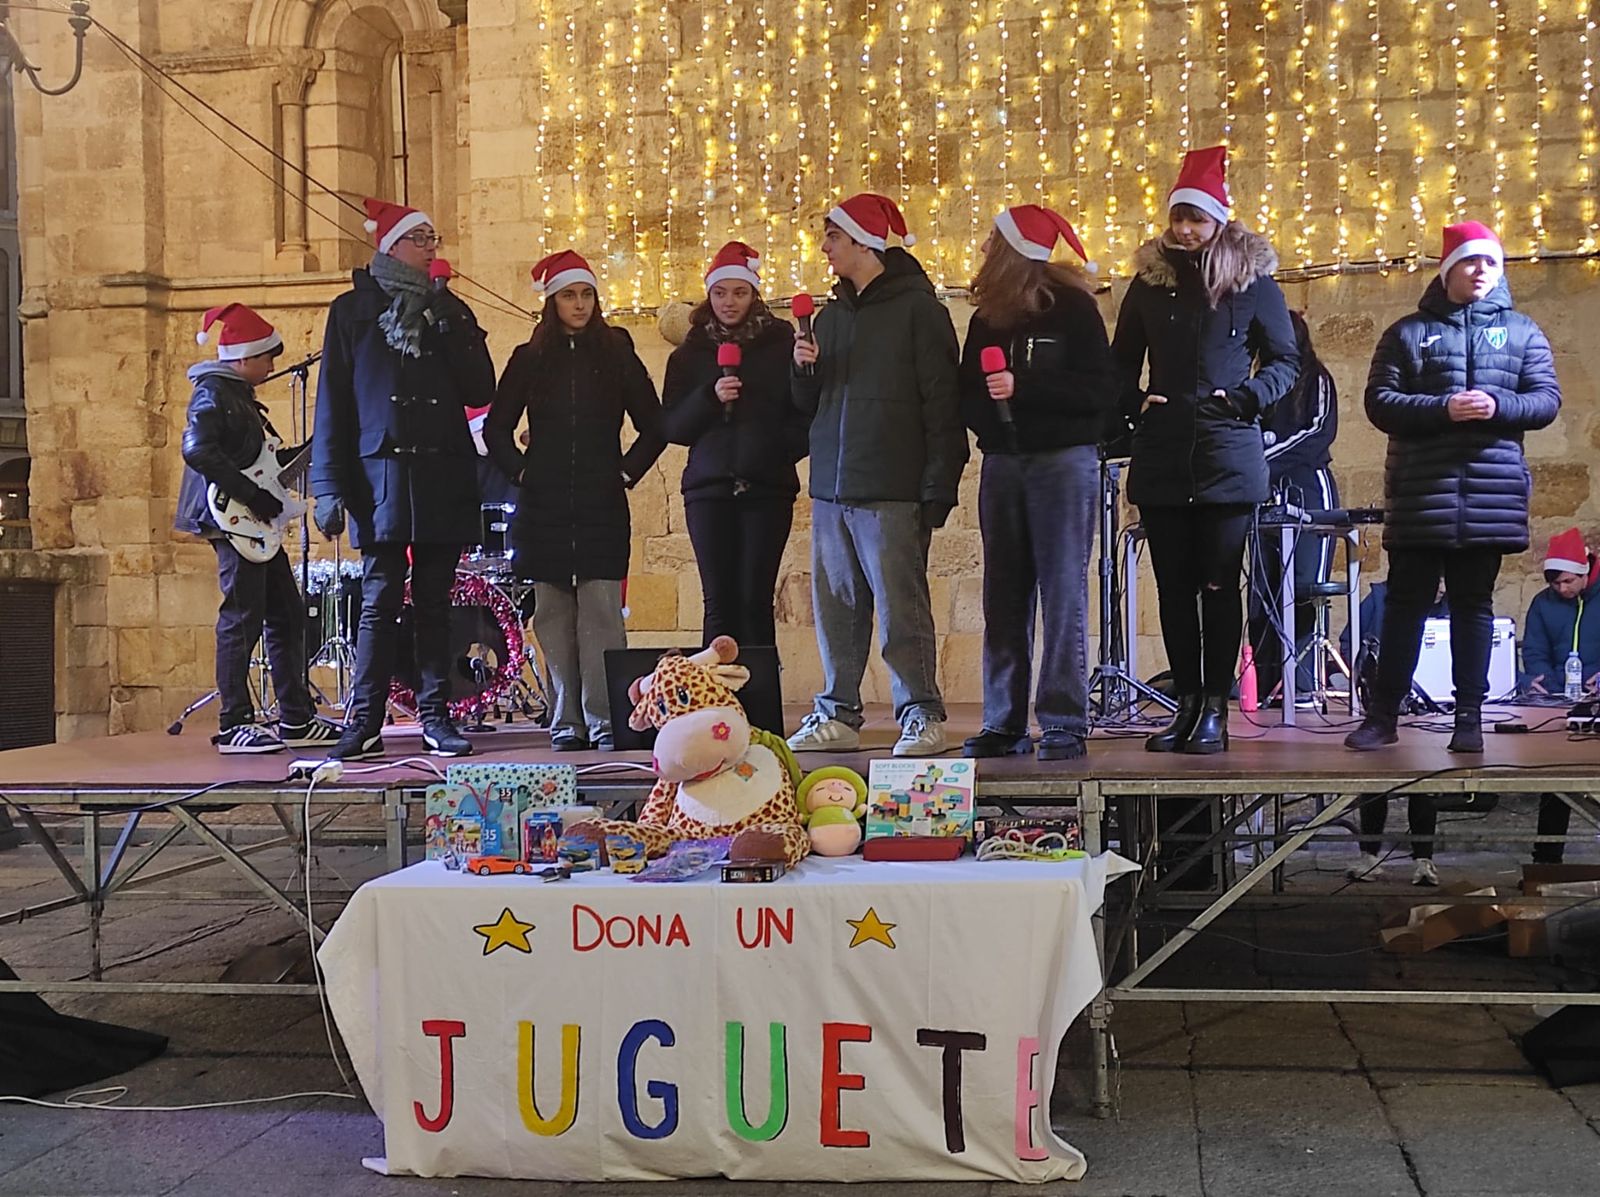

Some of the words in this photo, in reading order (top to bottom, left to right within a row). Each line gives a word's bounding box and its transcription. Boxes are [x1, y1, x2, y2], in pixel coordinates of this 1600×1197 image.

[500, 788, 512, 797] 35
[572, 904, 690, 952] DONA
[736, 907, 794, 949] UN
[413, 1018, 1050, 1162] JUGUETE
